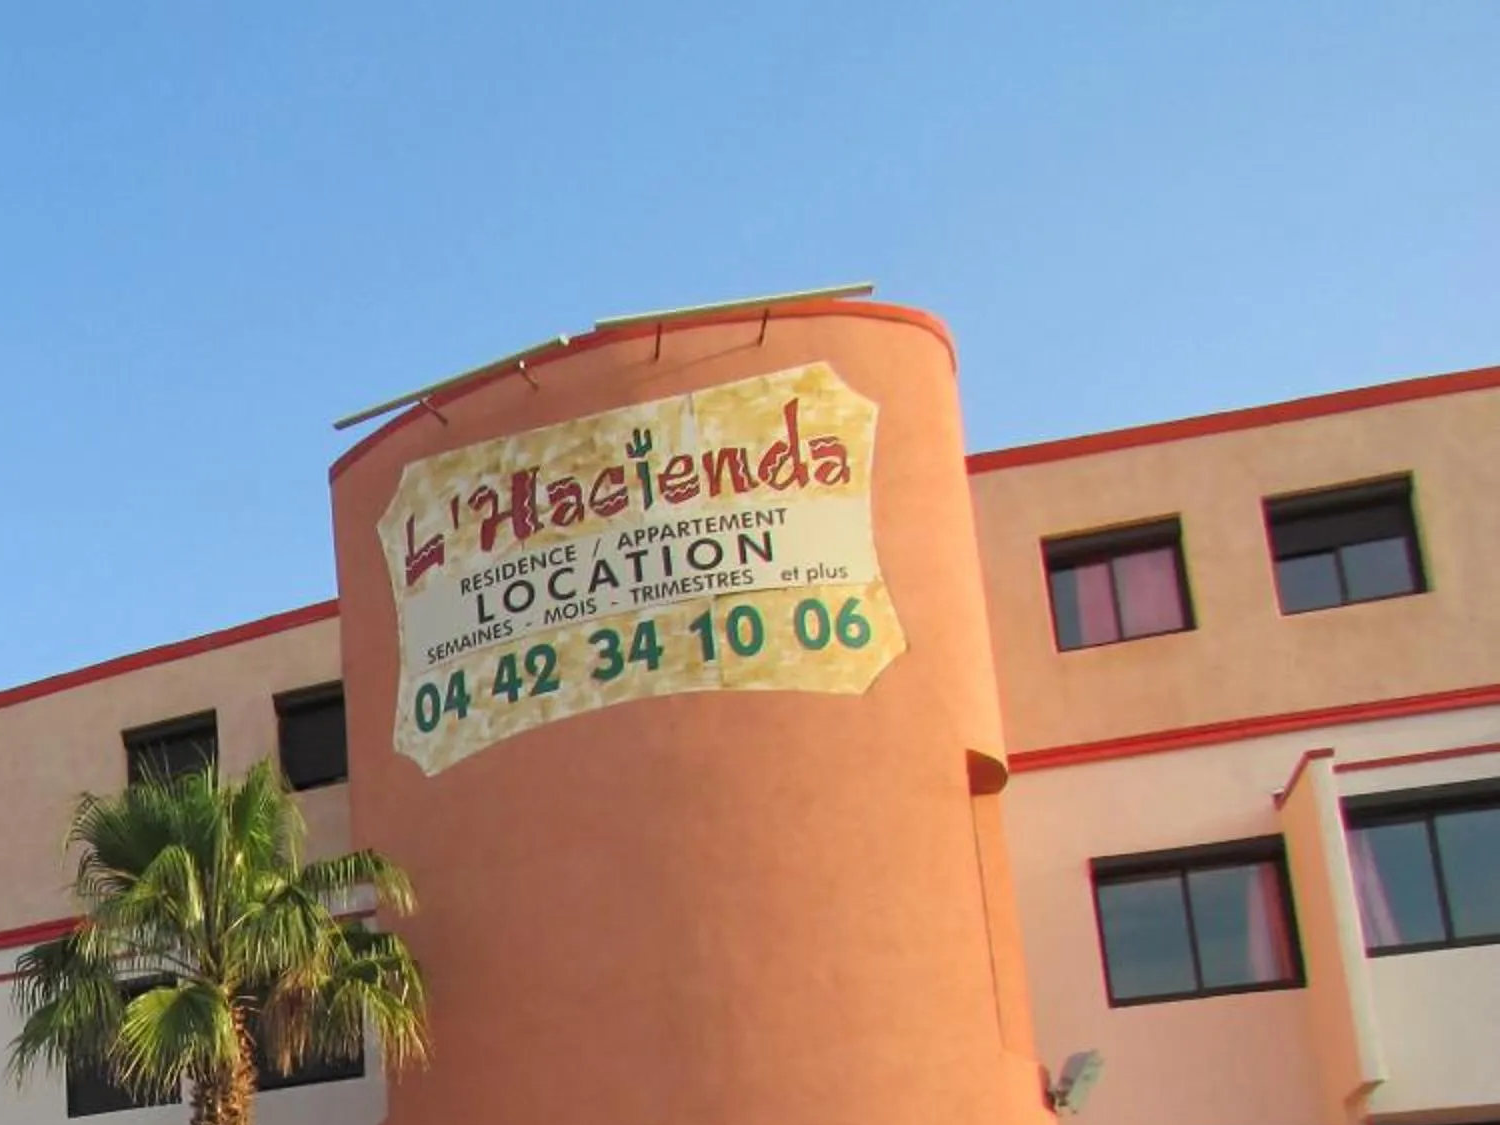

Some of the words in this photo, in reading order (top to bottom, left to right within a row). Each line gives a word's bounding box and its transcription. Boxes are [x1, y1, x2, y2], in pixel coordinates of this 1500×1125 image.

[405, 400, 851, 587] L'Hacienda
[460, 546, 577, 597] RESIDENCE
[617, 508, 789, 551] APPARTEMENT
[476, 531, 775, 625] LOCATION
[415, 669, 471, 733] 04
[491, 644, 561, 704] 42
[588, 619, 664, 682] 34
[690, 604, 764, 662] 10
[794, 597, 871, 651] 06
[427, 620, 514, 665] SEMAINES
[544, 599, 598, 625] MOIS
[630, 569, 754, 604] TRIMESTRES
[781, 568, 800, 582] et
[807, 563, 849, 583] plus
